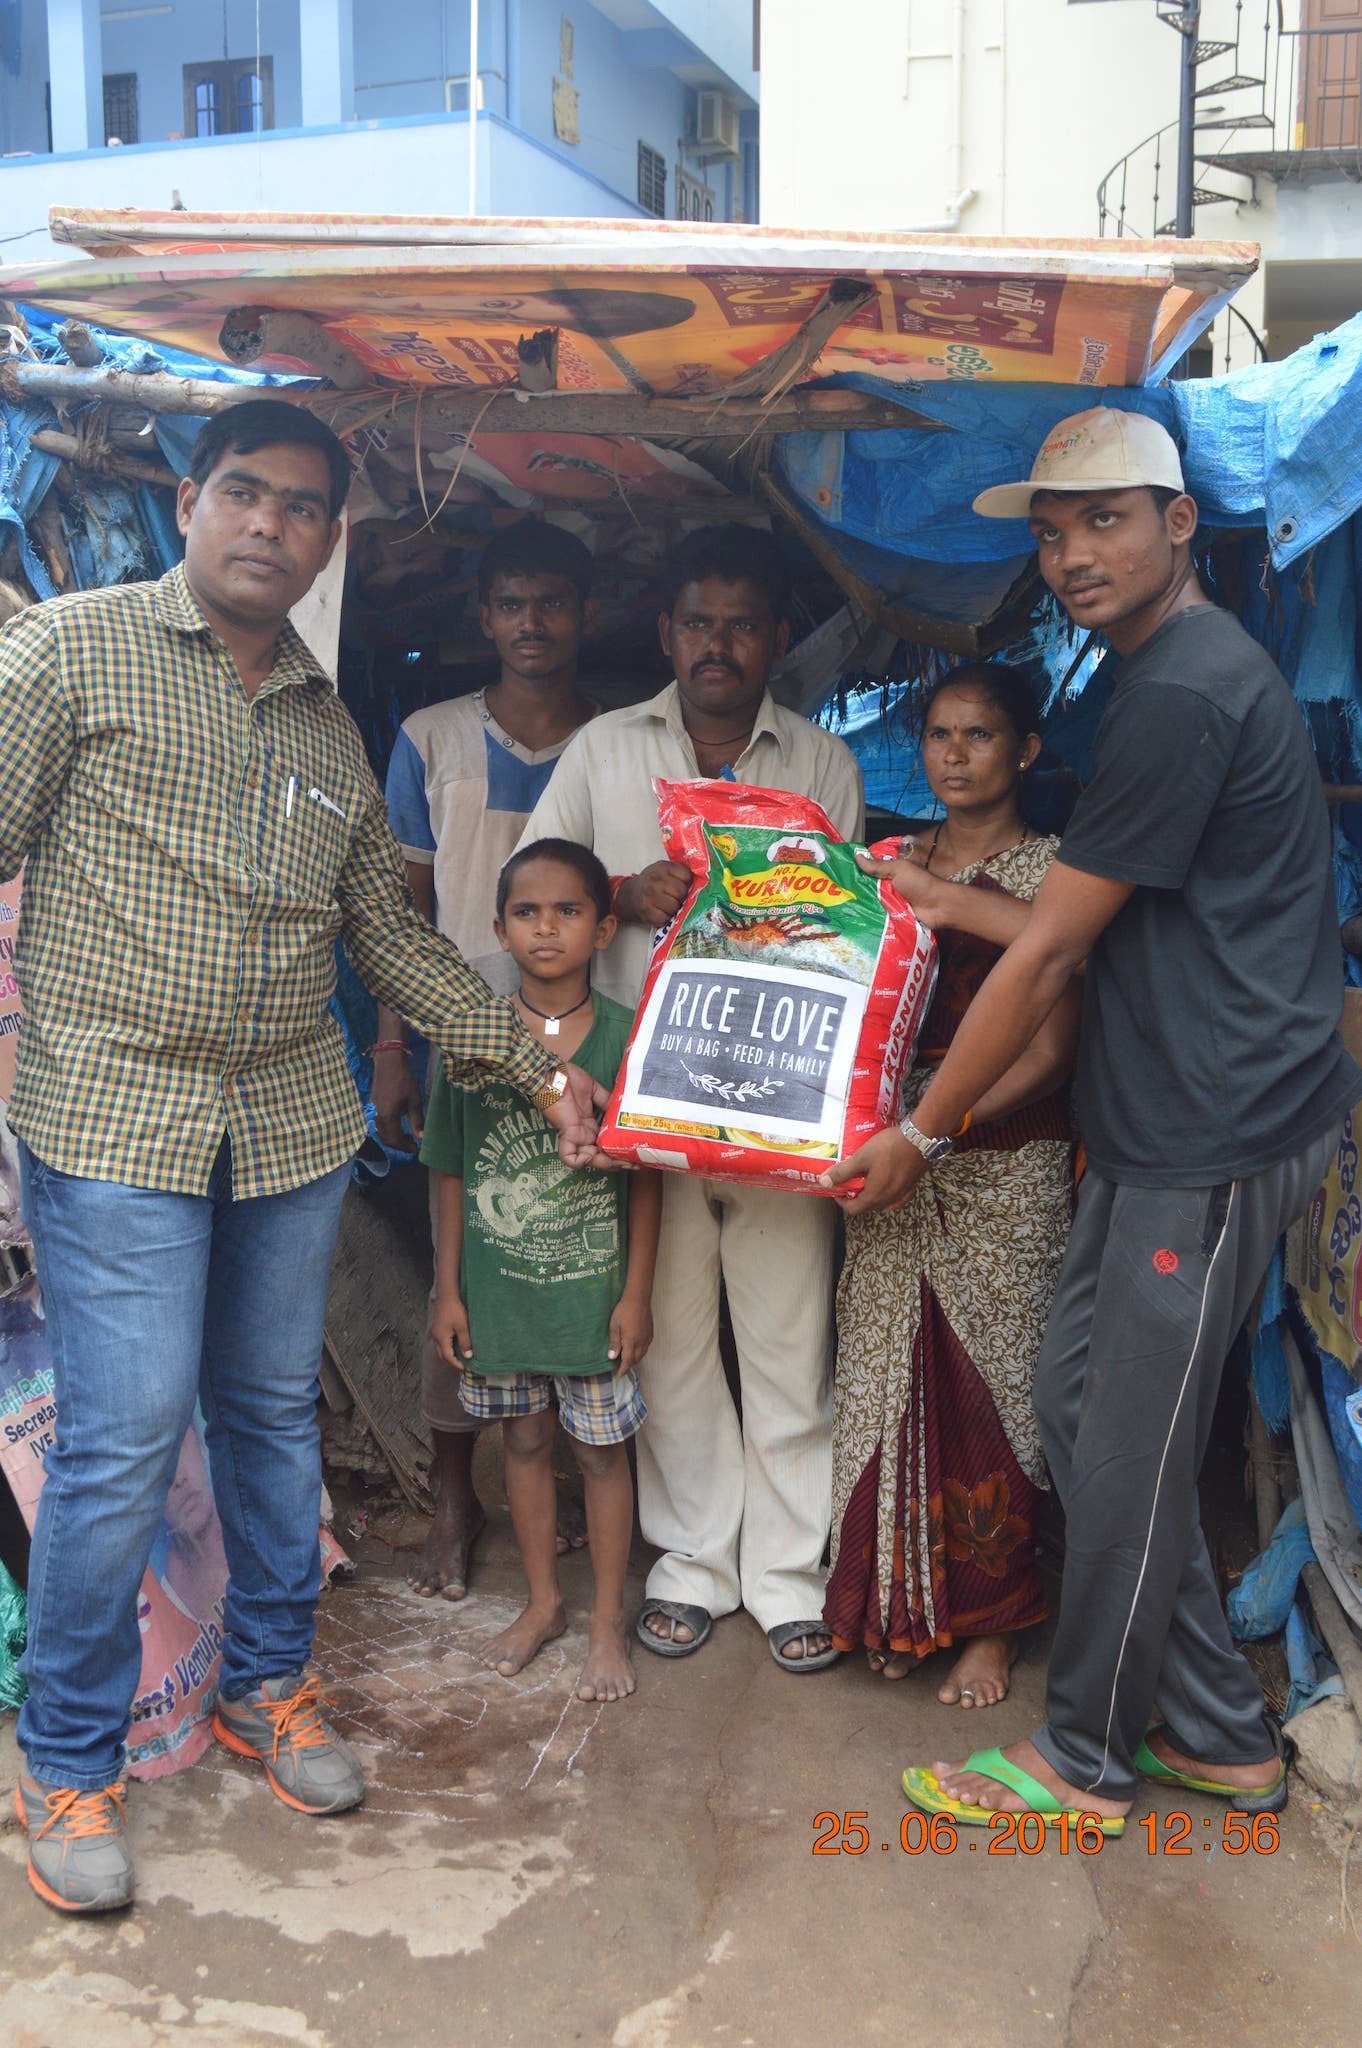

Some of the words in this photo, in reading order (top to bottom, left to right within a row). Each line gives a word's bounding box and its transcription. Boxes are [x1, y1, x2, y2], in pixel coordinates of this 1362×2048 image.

[731, 876, 842, 898] KURNOOL
[801, 903, 824, 914] Rice
[668, 982, 741, 1034] RICE
[750, 992, 839, 1052] LOVE
[884, 948, 929, 1082] KURNOOL
[660, 1034, 683, 1051] BUY
[684, 1038, 692, 1054] A
[696, 1038, 721, 1058] BAG
[733, 1044, 763, 1065] FEED
[766, 1052, 774, 1067] A
[780, 1052, 826, 1077] FAMILY
[475, 1132, 505, 1174] SAN
[532, 1214, 582, 1235] guitar
[5, 1402, 58, 1443] Secretar
